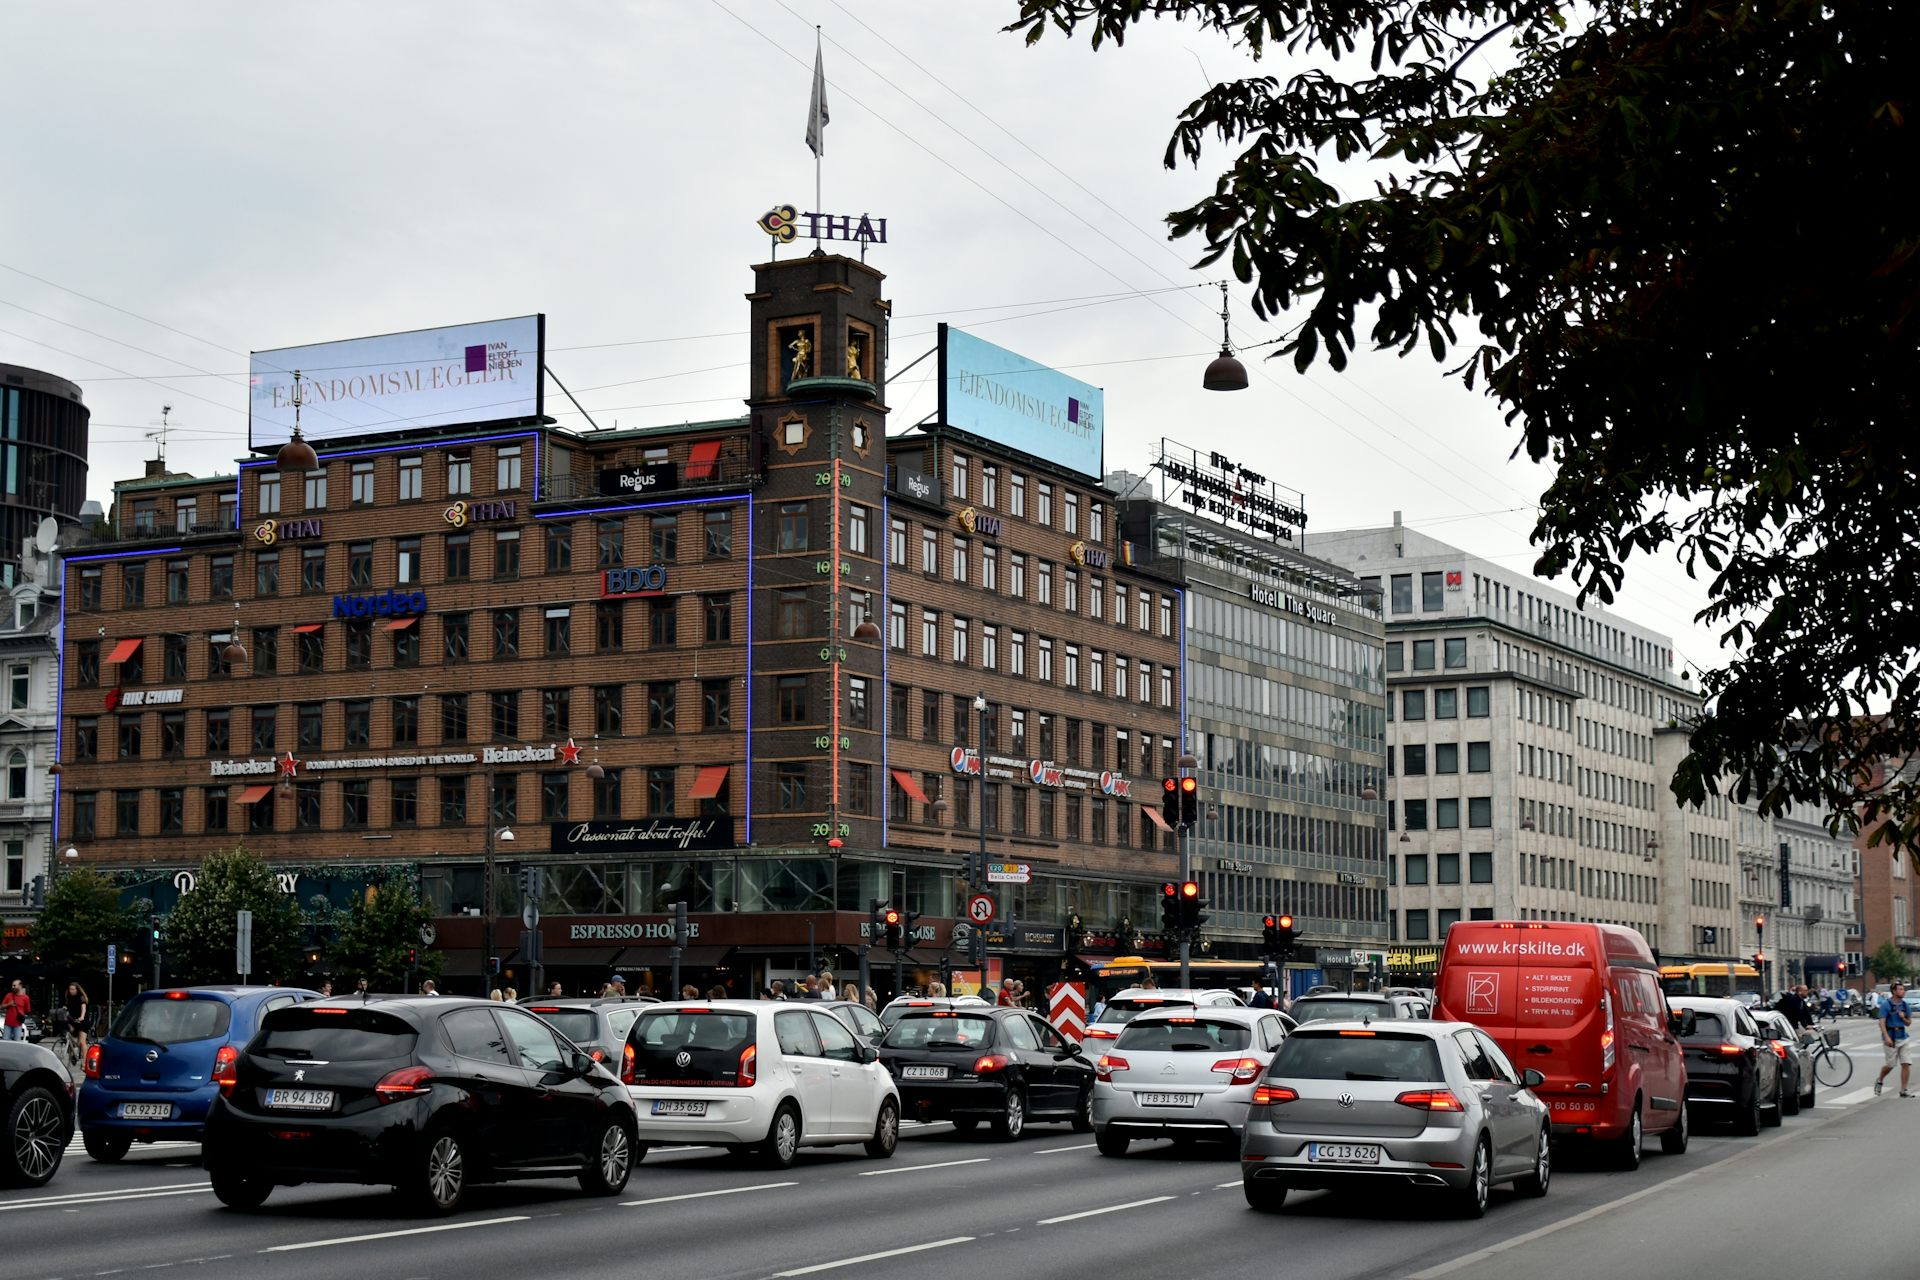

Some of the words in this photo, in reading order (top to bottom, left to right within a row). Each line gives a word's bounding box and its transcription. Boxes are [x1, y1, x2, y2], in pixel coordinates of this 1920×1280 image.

[802, 212, 887, 243] THAI
[488, 342, 507, 351] IVAN
[488, 359, 522, 371] NIELSEN
[620, 469, 656, 492] Regus
[816, 472, 831, 486] 20
[908, 475, 930, 498] Regus
[470, 500, 517, 522] THAI
[279, 519, 322, 540] THAI
[975, 512, 1003, 537] THAI
[816, 561, 831, 574] 10
[607, 565, 666, 593] BDO
[333, 587, 427, 619] Nordea
[1251, 584, 1278, 608] Hotel
[1286, 594, 1304, 616] The
[1306, 600, 1337, 626] Square
[820, 648, 830, 661] 0
[122, 692, 145, 706] AIR
[145, 689, 184, 705] CHINA
[815, 736, 830, 749] 10
[483, 746, 556, 764] Heineken
[210, 759, 276, 776] Heineken
[568, 822, 642, 843] Passionate
[638, 820, 682, 840] about
[672, 820, 715, 849] coffee!
[813, 823, 829, 836] 20
[571, 923, 644, 939] ESPRESSO
[1458, 940, 1585, 957] www.krskilte.dk
[1326, 955, 1347, 963] Hotel
[1531, 974, 1544, 982] ALT
[1550, 974, 1573, 983] SKILTE
[1531, 985, 1569, 993] STORPRINT
[1530, 997, 1584, 1005] BILDEKORATION
[1531, 1008, 1550, 1016] TRYK
[1550, 1007, 1560, 1016] PÅ
[1561, 1008, 1575, 1017] TØJ
[906, 1067, 917, 1076] CZ
[919, 1067, 928, 1076] 11
[929, 1067, 946, 1077] 068
[273, 1090, 289, 1104] BR
[291, 1091, 307, 1104] 94
[309, 1091, 331, 1105] 186
[1161, 1094, 1171, 1104] 31
[1173, 1094, 1189, 1104] 591
[125, 1104, 138, 1115] CR
[139, 1104, 151, 1116] 92
[151, 1104, 170, 1116] 316
[658, 1101, 672, 1111] DH
[674, 1101, 686, 1112] 35
[687, 1101, 706, 1112] 653
[1555, 1102, 1566, 1110] 60
[1569, 1102, 1581, 1111] 50
[1584, 1102, 1596, 1111] 80
[1318, 1145, 1335, 1158] CG
[1337, 1146, 1352, 1158] 13
[1354, 1146, 1377, 1159] 626
